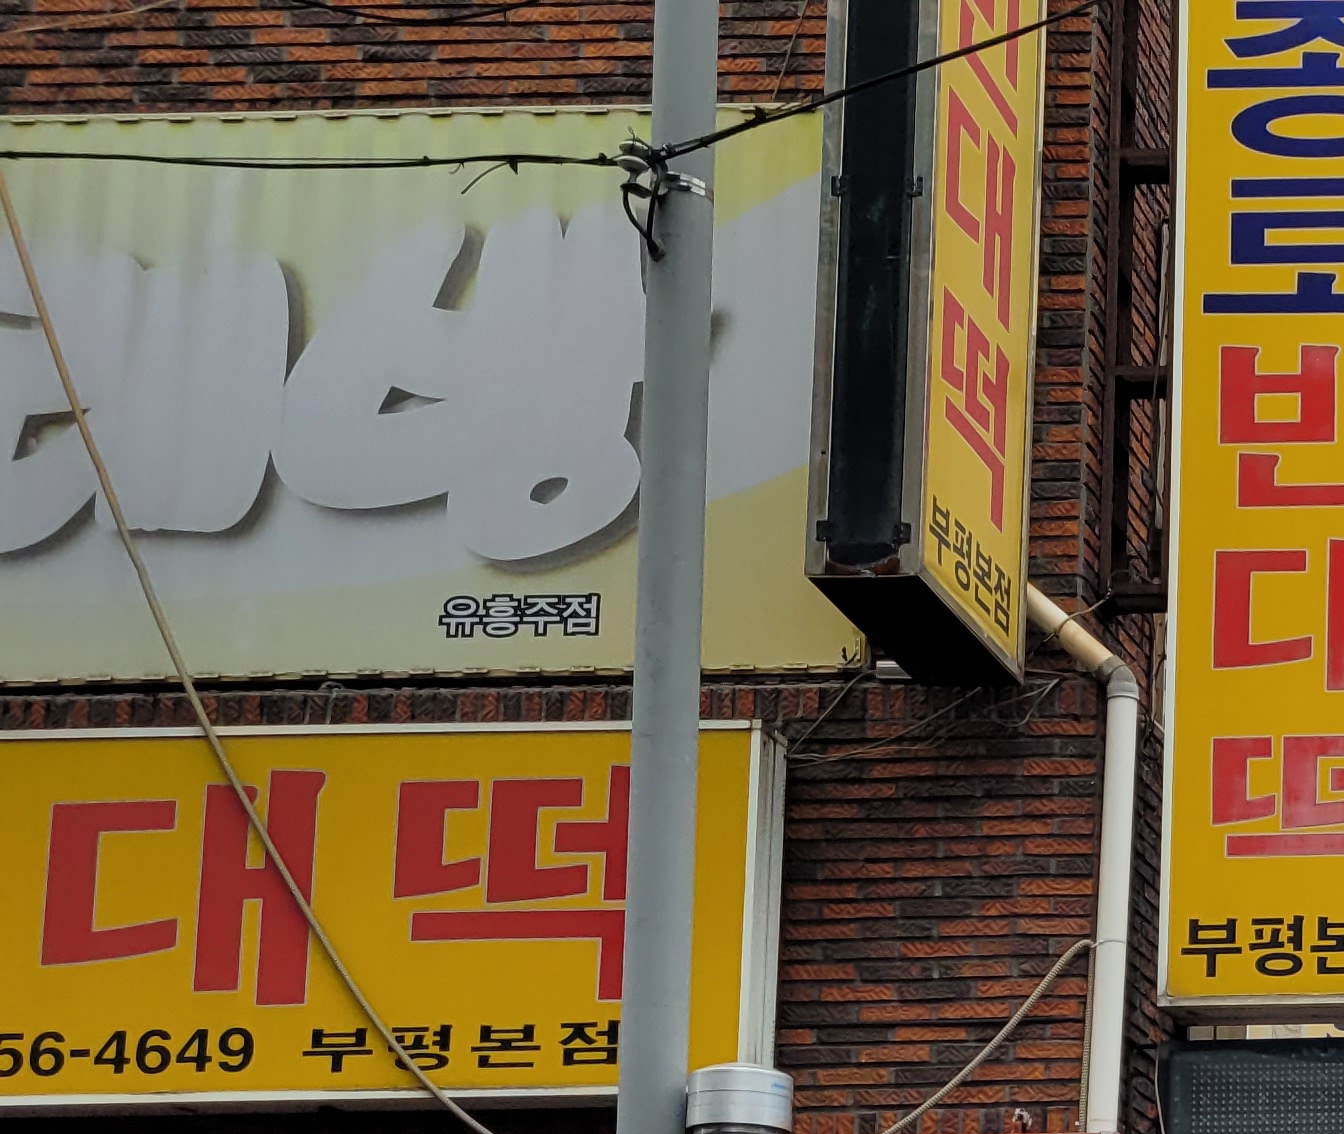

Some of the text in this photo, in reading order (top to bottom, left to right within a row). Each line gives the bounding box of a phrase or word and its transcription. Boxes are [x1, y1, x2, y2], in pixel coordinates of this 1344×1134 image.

[929, 494, 1012, 637] 부평본점
[438, 593, 601, 637] 유흥주점
[302, 1020, 621, 1073] 부평본점
